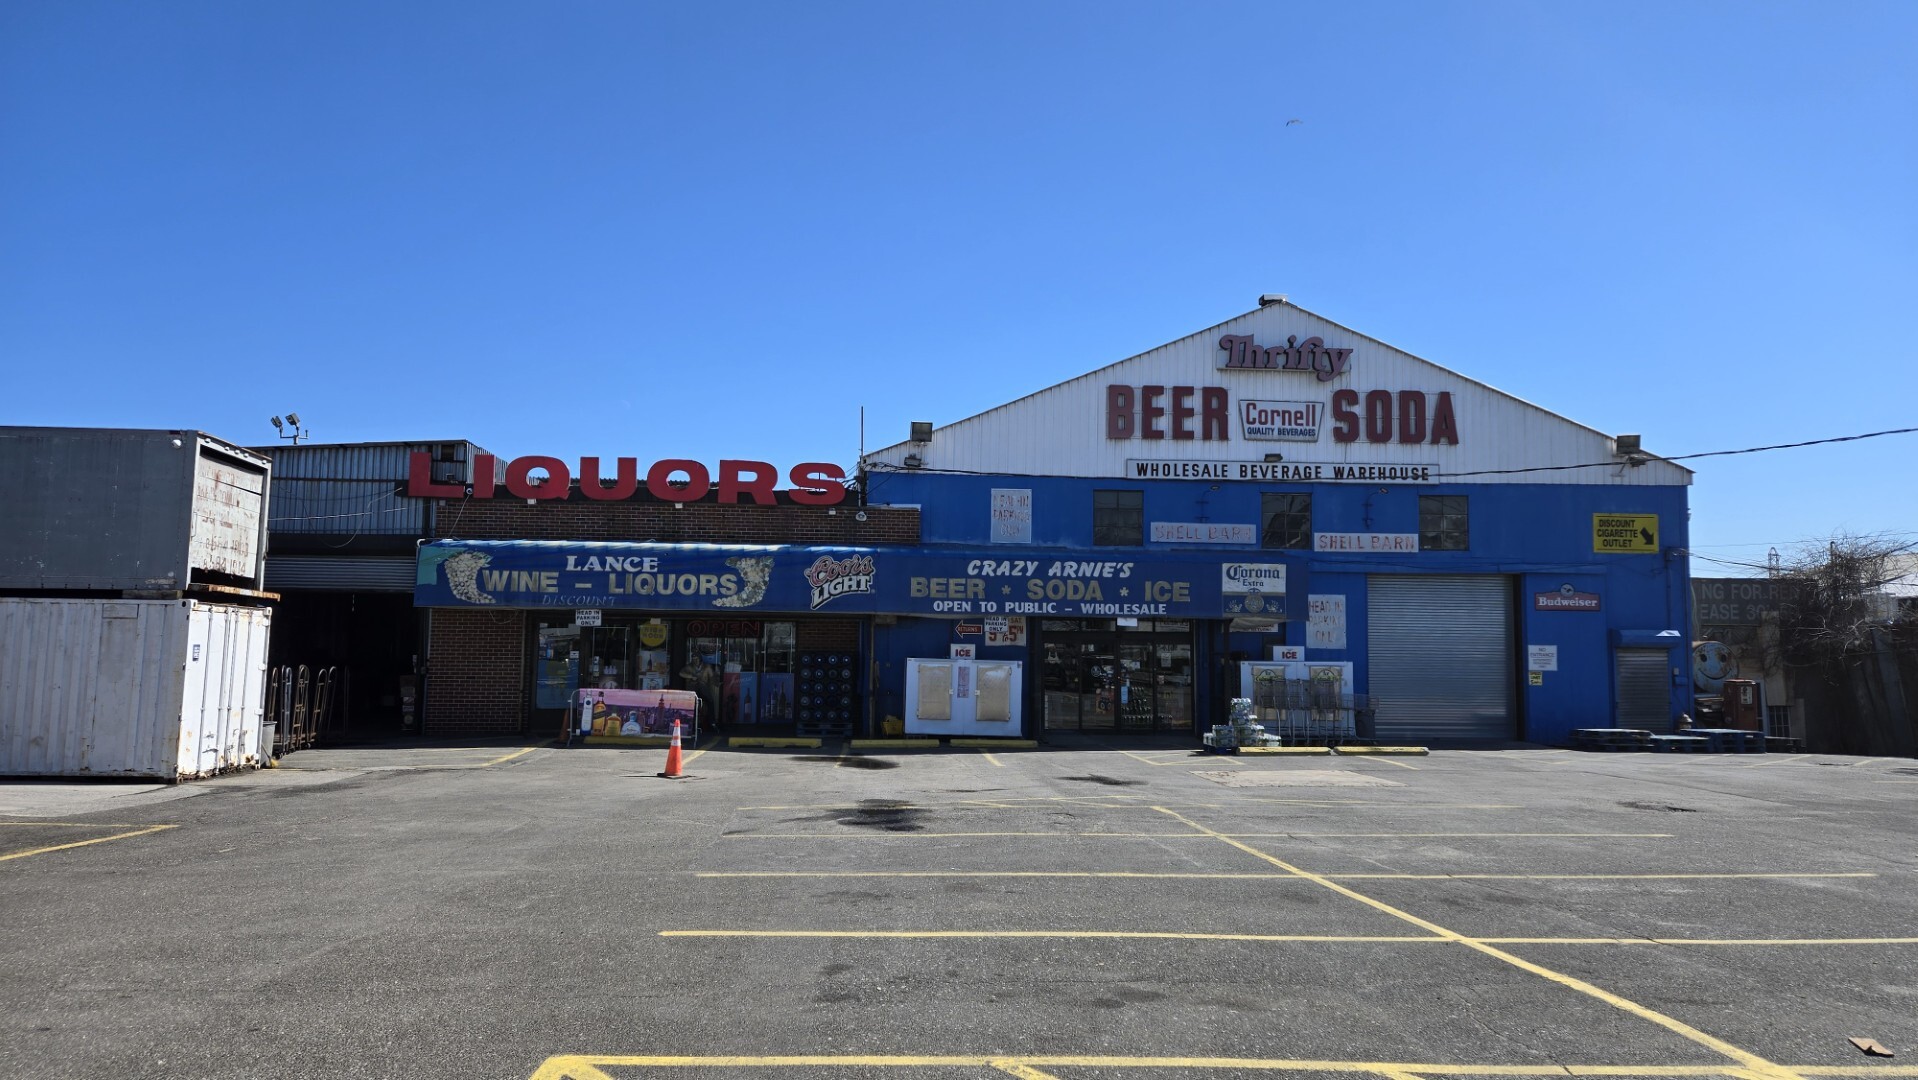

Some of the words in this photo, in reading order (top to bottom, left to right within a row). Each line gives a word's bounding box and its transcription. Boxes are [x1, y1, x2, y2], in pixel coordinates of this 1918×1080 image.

[1219, 334, 1354, 382] Thrifty
[1107, 384, 1229, 441] BEER
[1246, 402, 1316, 427] Cornell
[1332, 389, 1459, 445] SODA
[1247, 427, 1275, 436] QUALITY
[1277, 428, 1316, 437] BEVERAGES
[408, 452, 847, 506] LIQUORS
[1136, 463, 1229, 479] WHOLESALE
[1239, 464, 1322, 480] BEVERAGE
[1333, 466, 1430, 482] WAREHOUSE
[1599, 519, 1636, 528] DISCOUNT
[1155, 524, 1202, 540] SHELL
[1597, 529, 1639, 538] CIGARETTE
[1319, 535, 1364, 549] SHELL
[1371, 535, 1415, 550] BARN
[1602, 539, 1633, 548] OUTLET
[566, 555, 660, 573] LANCE
[804, 554, 876, 589] Coors
[967, 560, 1040, 577] CRAZY
[1048, 562, 1135, 578] ARNIE'S
[1226, 565, 1281, 581] Corona
[482, 570, 559, 593] WINE
[608, 573, 738, 596] LIQUORS
[910, 577, 985, 599] BEER
[1027, 579, 1103, 601] SODA
[1144, 581, 1191, 602] ICE
[1242, 579, 1264, 587] Extra
[811, 575, 872, 609] LIGHT
[1702, 583, 1724, 600] NG
[1731, 584, 1762, 600] FOR
[541, 594, 618, 606] DISCOUNT
[933, 601, 971, 613] OPEN
[979, 602, 997, 613] TO
[1005, 602, 1057, 614] PUBLIC
[1080, 603, 1167, 615] WHOLESALE
[1309, 601, 1331, 613] HEAD
[1538, 596, 1598, 607] Budweiser
[1701, 604, 1740, 620] EASE
[687, 621, 760, 637] OPEN
[955, 649, 971, 657] ICE
[1281, 651, 1298, 660] ICE
